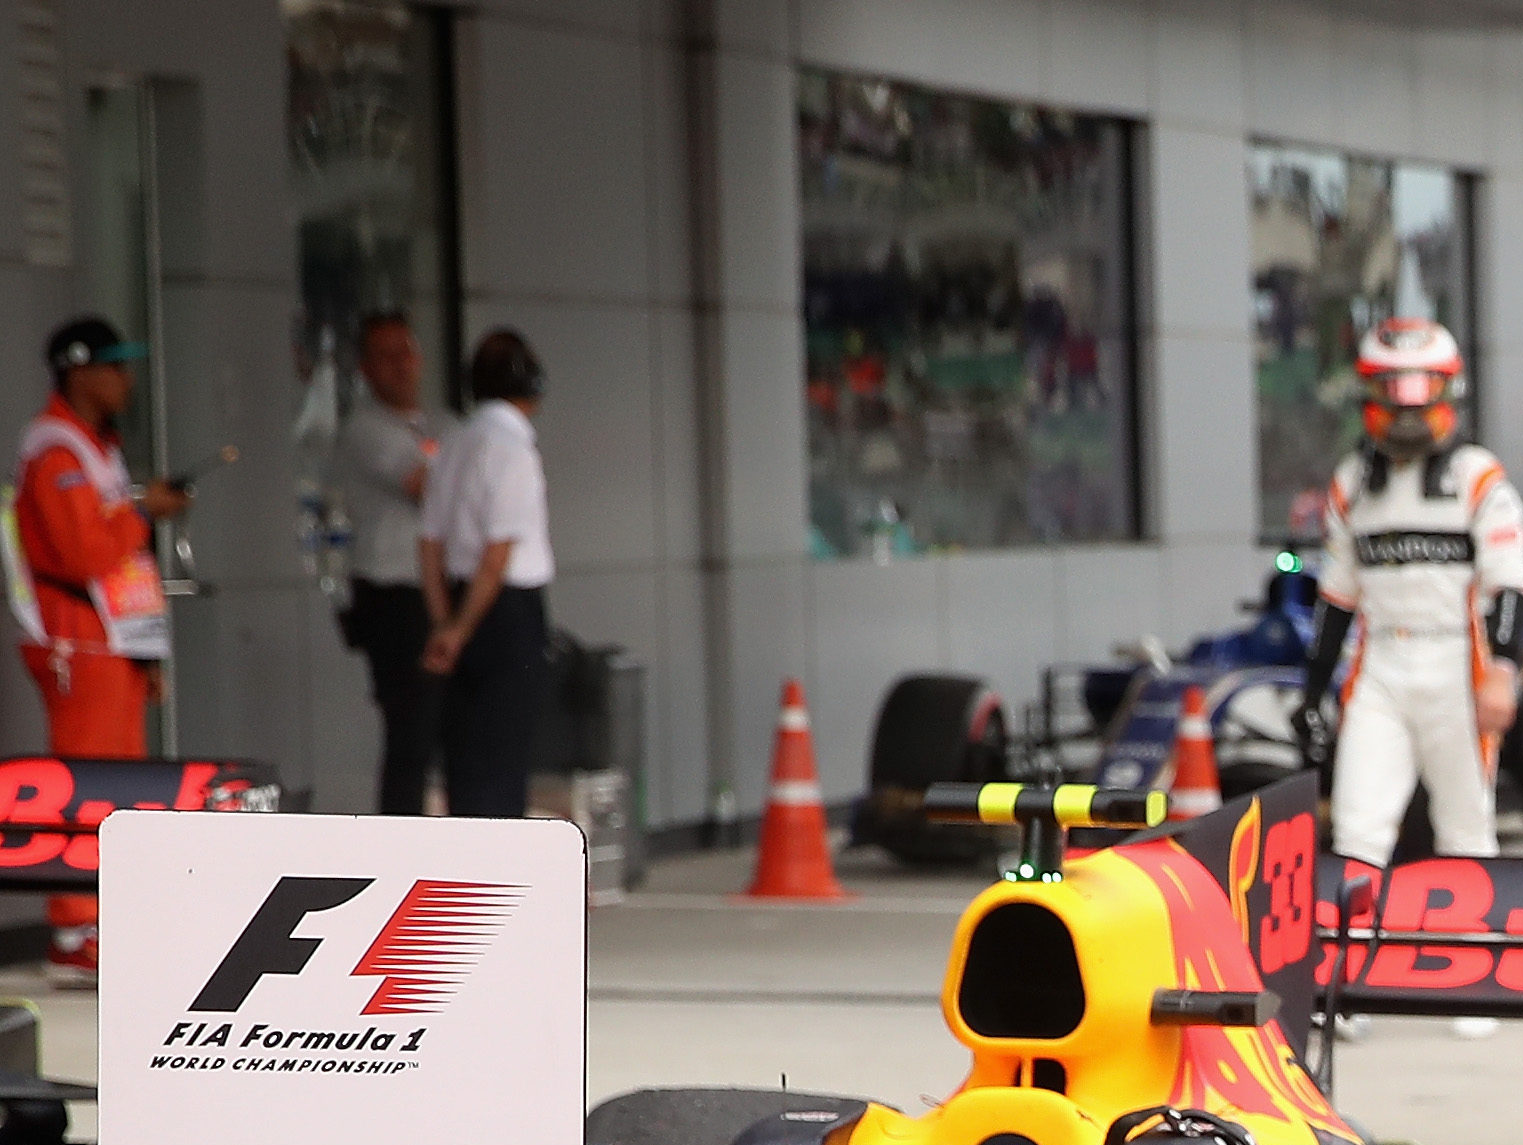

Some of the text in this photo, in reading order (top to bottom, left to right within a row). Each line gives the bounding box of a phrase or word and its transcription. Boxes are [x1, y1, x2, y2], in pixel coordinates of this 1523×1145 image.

[187, 876, 533, 1016] F1
[163, 1022, 428, 1052] FIA Formula 1
[149, 1055, 226, 1072] WORLD
